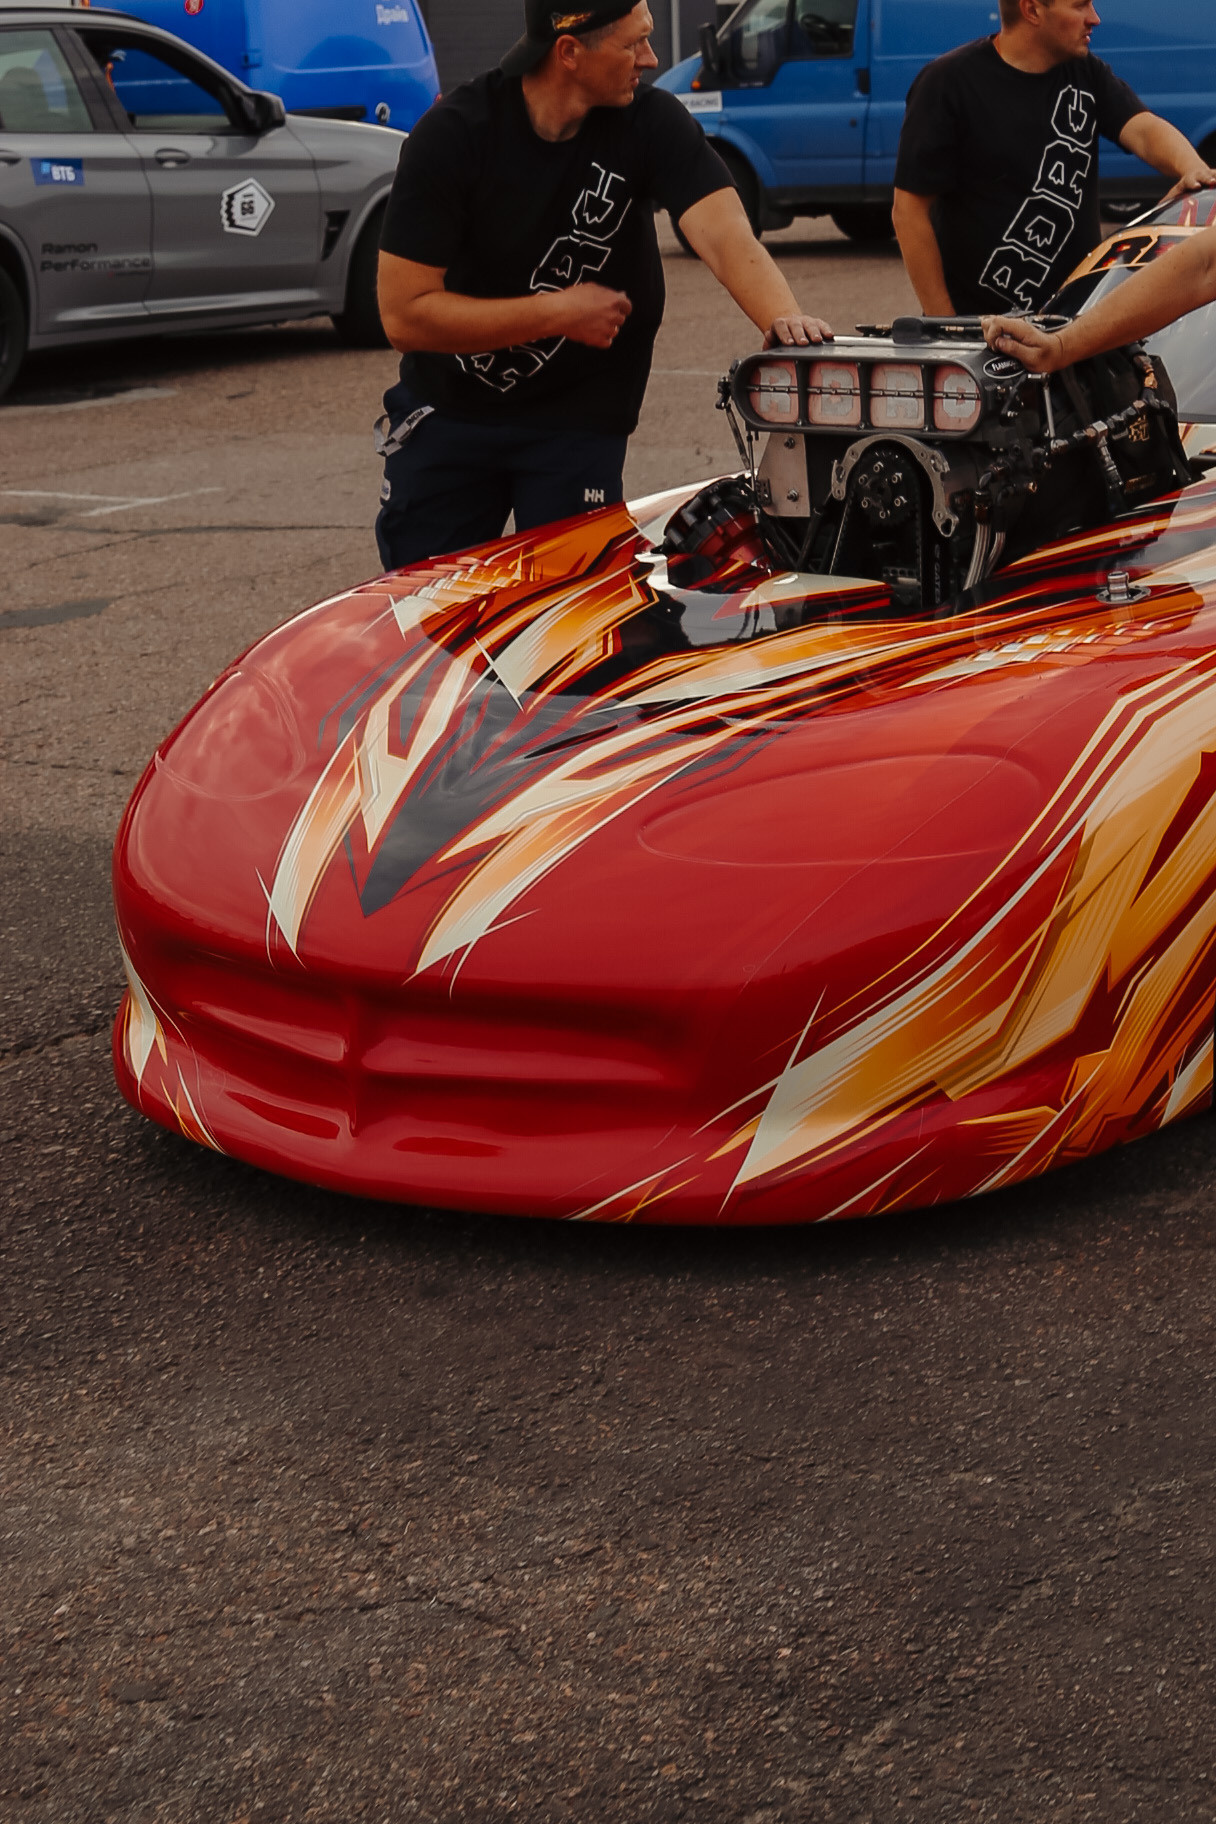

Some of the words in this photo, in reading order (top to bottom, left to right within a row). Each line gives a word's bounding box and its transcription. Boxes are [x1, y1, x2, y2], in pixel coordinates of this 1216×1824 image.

[51, 165, 76, 182] ВТБ
[41, 243, 98, 254] Ramon
[584, 488, 605, 503] HH
